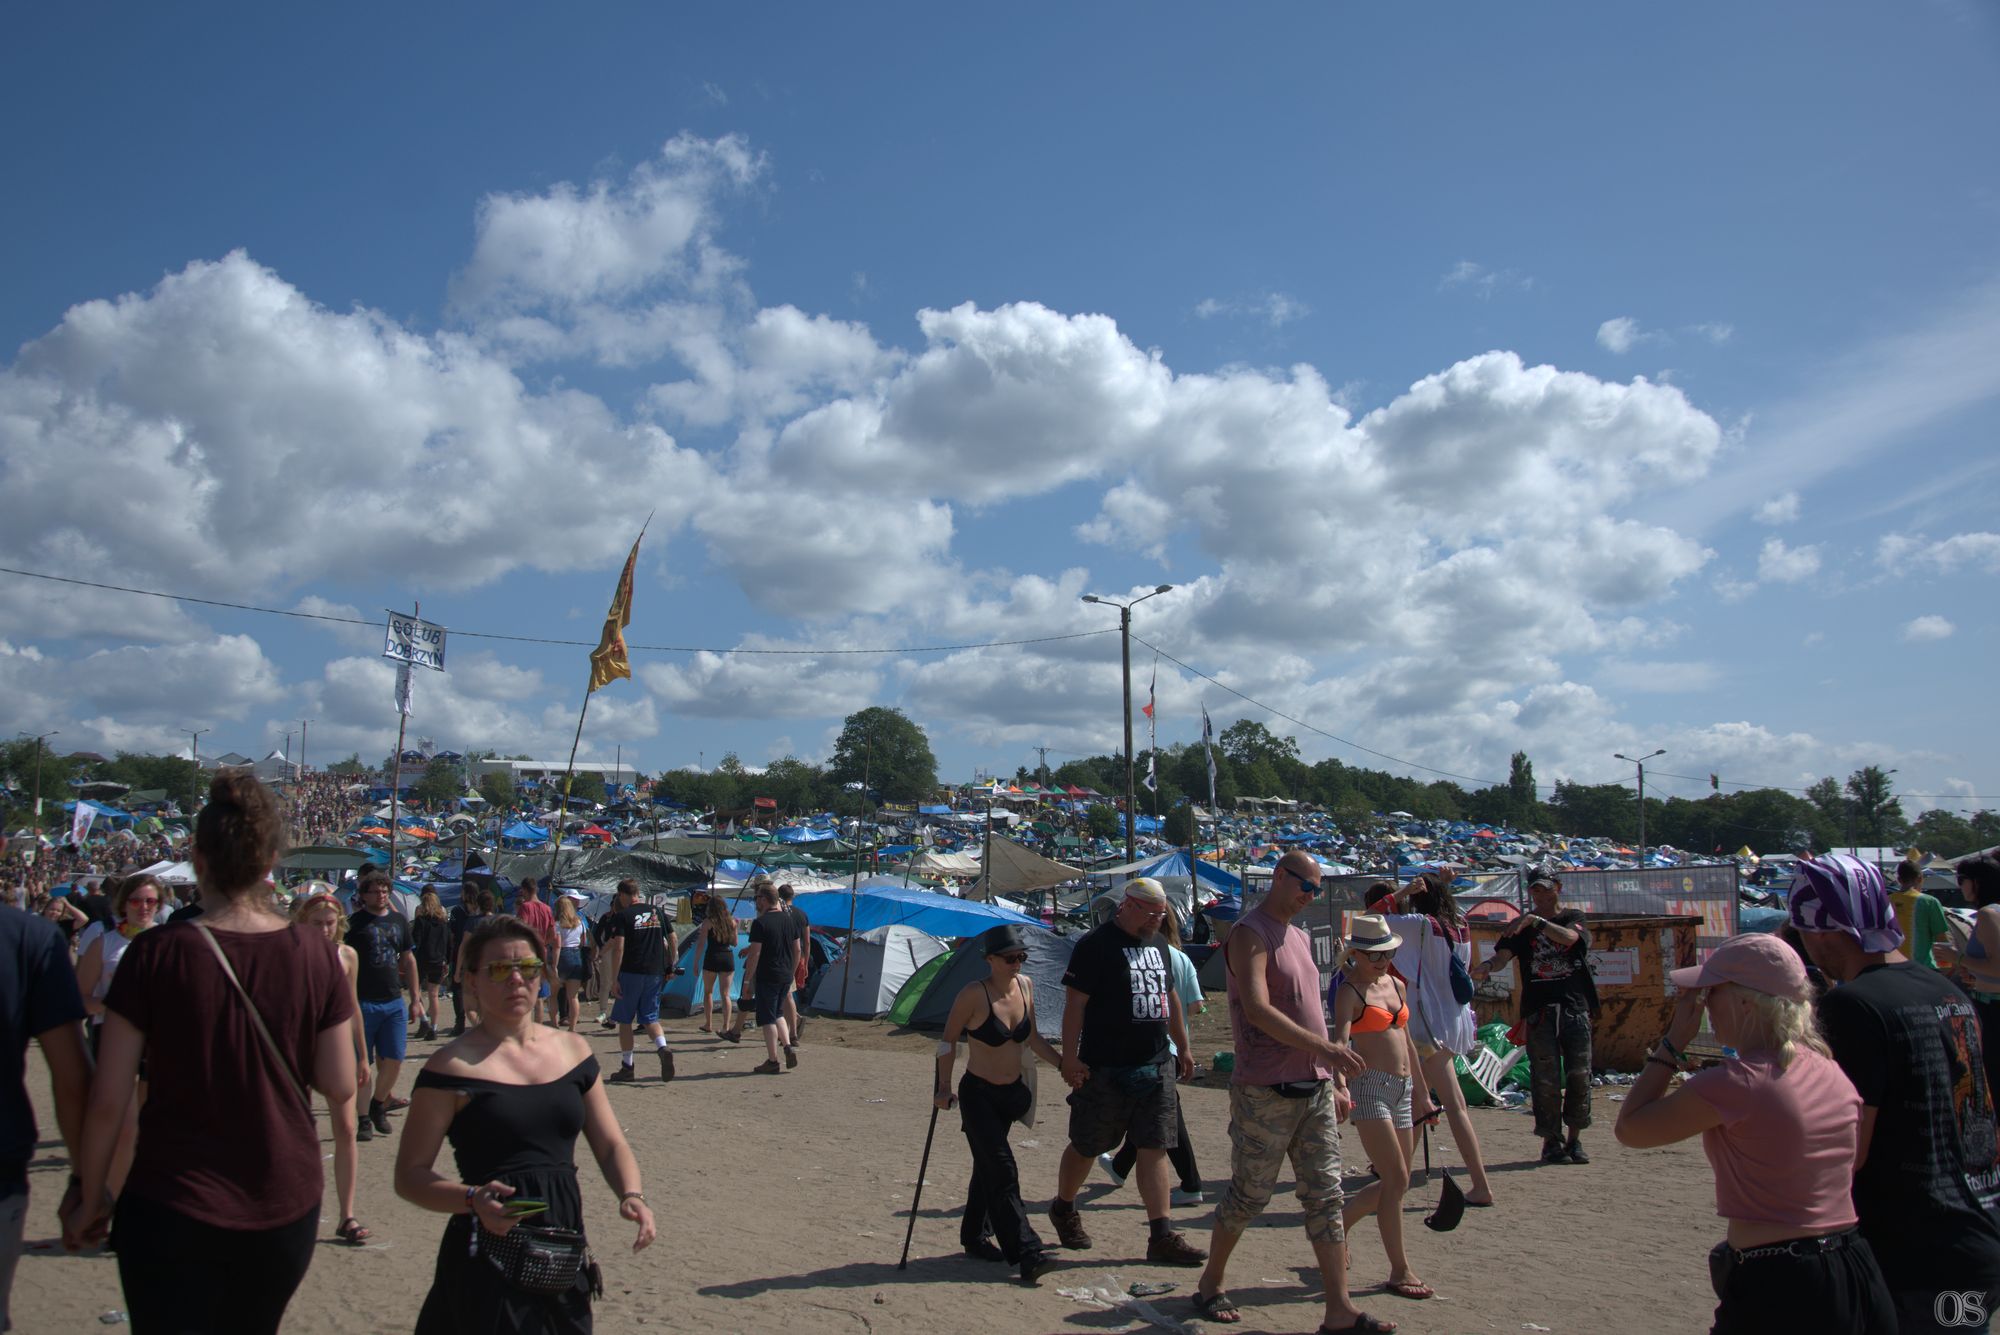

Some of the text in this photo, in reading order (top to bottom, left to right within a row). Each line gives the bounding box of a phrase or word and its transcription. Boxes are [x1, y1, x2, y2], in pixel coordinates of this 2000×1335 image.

[393, 620, 441, 644] GOLUB
[386, 639, 443, 666] DOBRZYŃ
[1856, 870, 1870, 899] PLAY
[1130, 969, 1167, 994] DST
